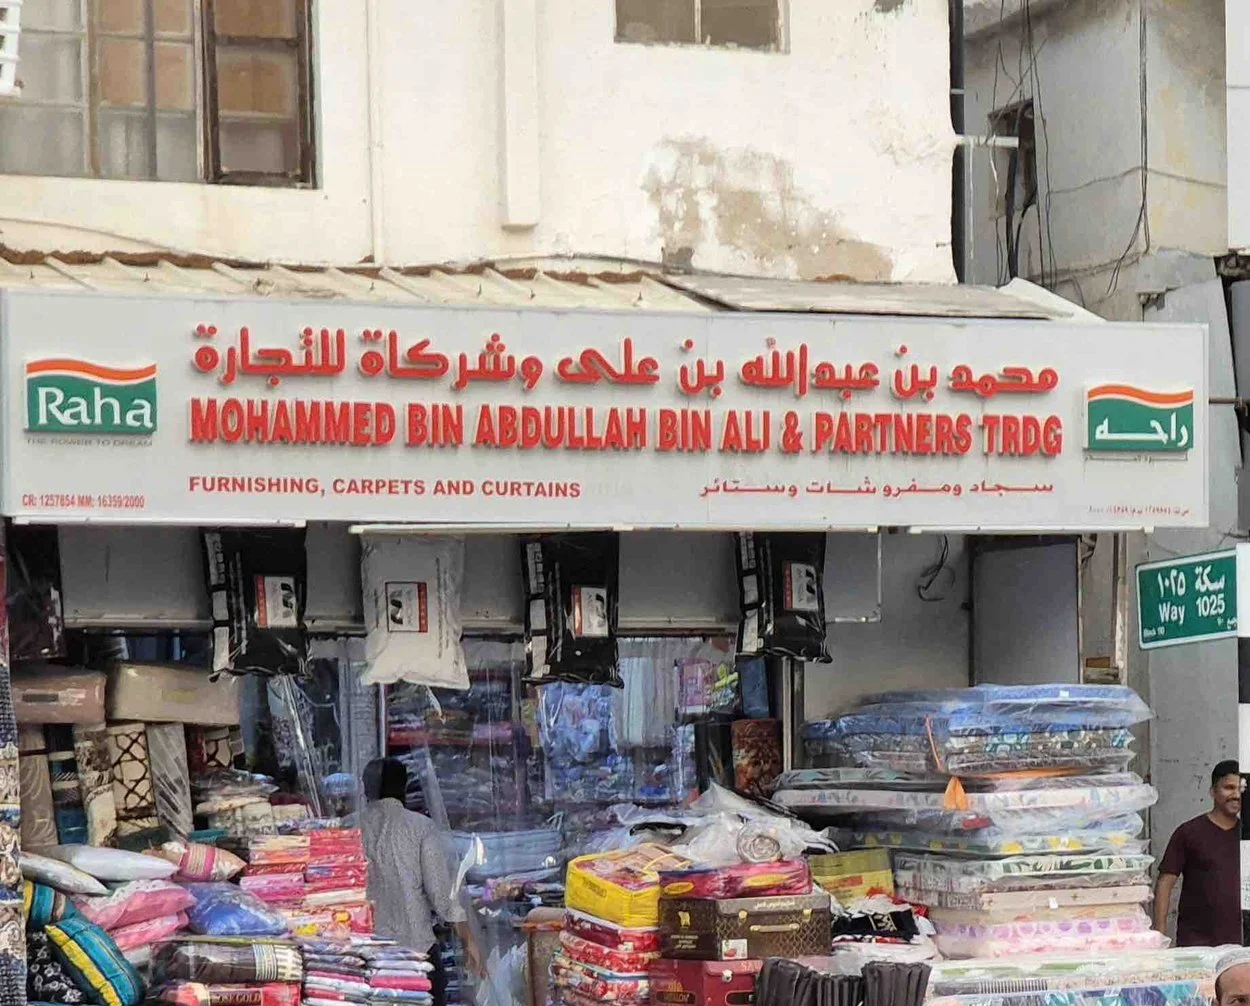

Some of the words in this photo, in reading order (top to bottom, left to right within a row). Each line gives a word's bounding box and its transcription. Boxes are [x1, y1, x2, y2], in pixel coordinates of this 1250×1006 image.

[194, 324, 346, 387] للتجارة
[678, 338, 725, 397] بن
[895, 344, 938, 400] بن
[950, 363, 1060, 398] محمد
[38, 387, 153, 428] Raha
[190, 398, 396, 445] MOHAMMED
[407, 402, 464, 446] BIN
[474, 405, 647, 449] ABDULLAH
[658, 409, 712, 450] BIN
[721, 410, 771, 451] ALI
[781, 411, 804, 453] &
[814, 412, 973, 455] PARTNERS
[981, 415, 1062, 456] TRDG
[189, 476, 325, 497] FURNISHING,
[332, 478, 426, 495] CARPETS
[433, 479, 474, 495] AND
[482, 480, 581, 498] CURTAINS
[699, 477, 798, 497] وستائر
[969, 479, 1054, 498] سجاد
[1158, 569, 1186, 597] ١٠٢٥
[1194, 565, 1225, 592] سكة
[1159, 601, 1185, 625] Way
[1195, 593, 1225, 617] 1025
